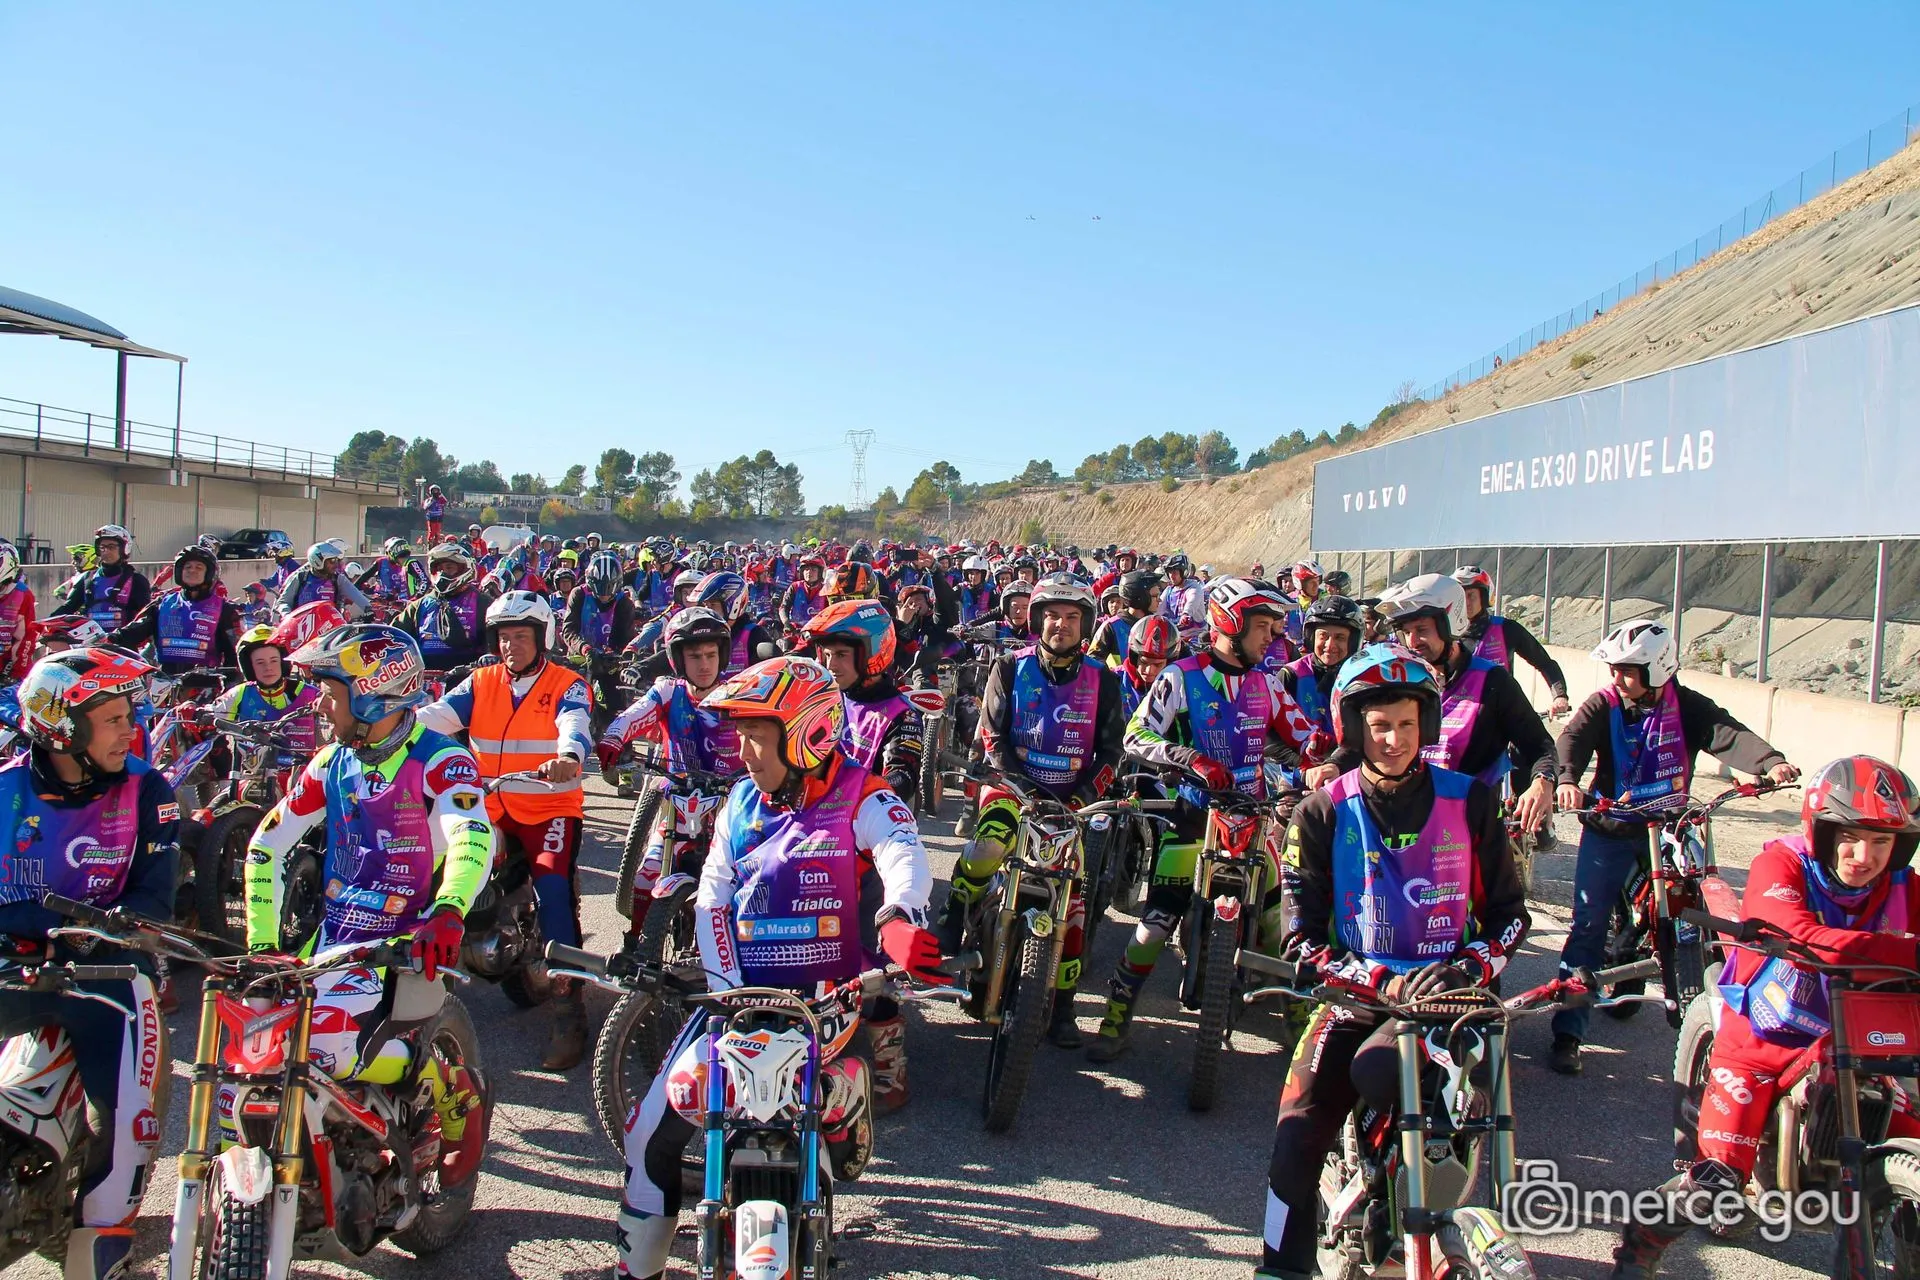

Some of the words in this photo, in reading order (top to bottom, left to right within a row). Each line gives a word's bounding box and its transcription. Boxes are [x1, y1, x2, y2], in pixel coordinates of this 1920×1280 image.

[1480, 461, 1525, 494] EMEA
[1530, 455, 1577, 488] EX30
[1585, 440, 1654, 484] DRIVE
[1661, 429, 1714, 474] LAB
[1342, 484, 1407, 513] VOLVO
[355, 665, 390, 695] Red
[387, 649, 416, 680] Bull
[1056, 745, 1085, 755] TrialGo
[1655, 765, 1684, 779] TrialGo
[798, 869, 829, 885] fcm
[791, 896, 843, 912] TrialGo
[766, 922, 811, 935] Marató
[1427, 915, 1451, 929] fcm
[139, 999, 161, 1091] HONDA
[725, 1038, 767, 1052] REPSOL
[1702, 1129, 1758, 1147] GASGAS
